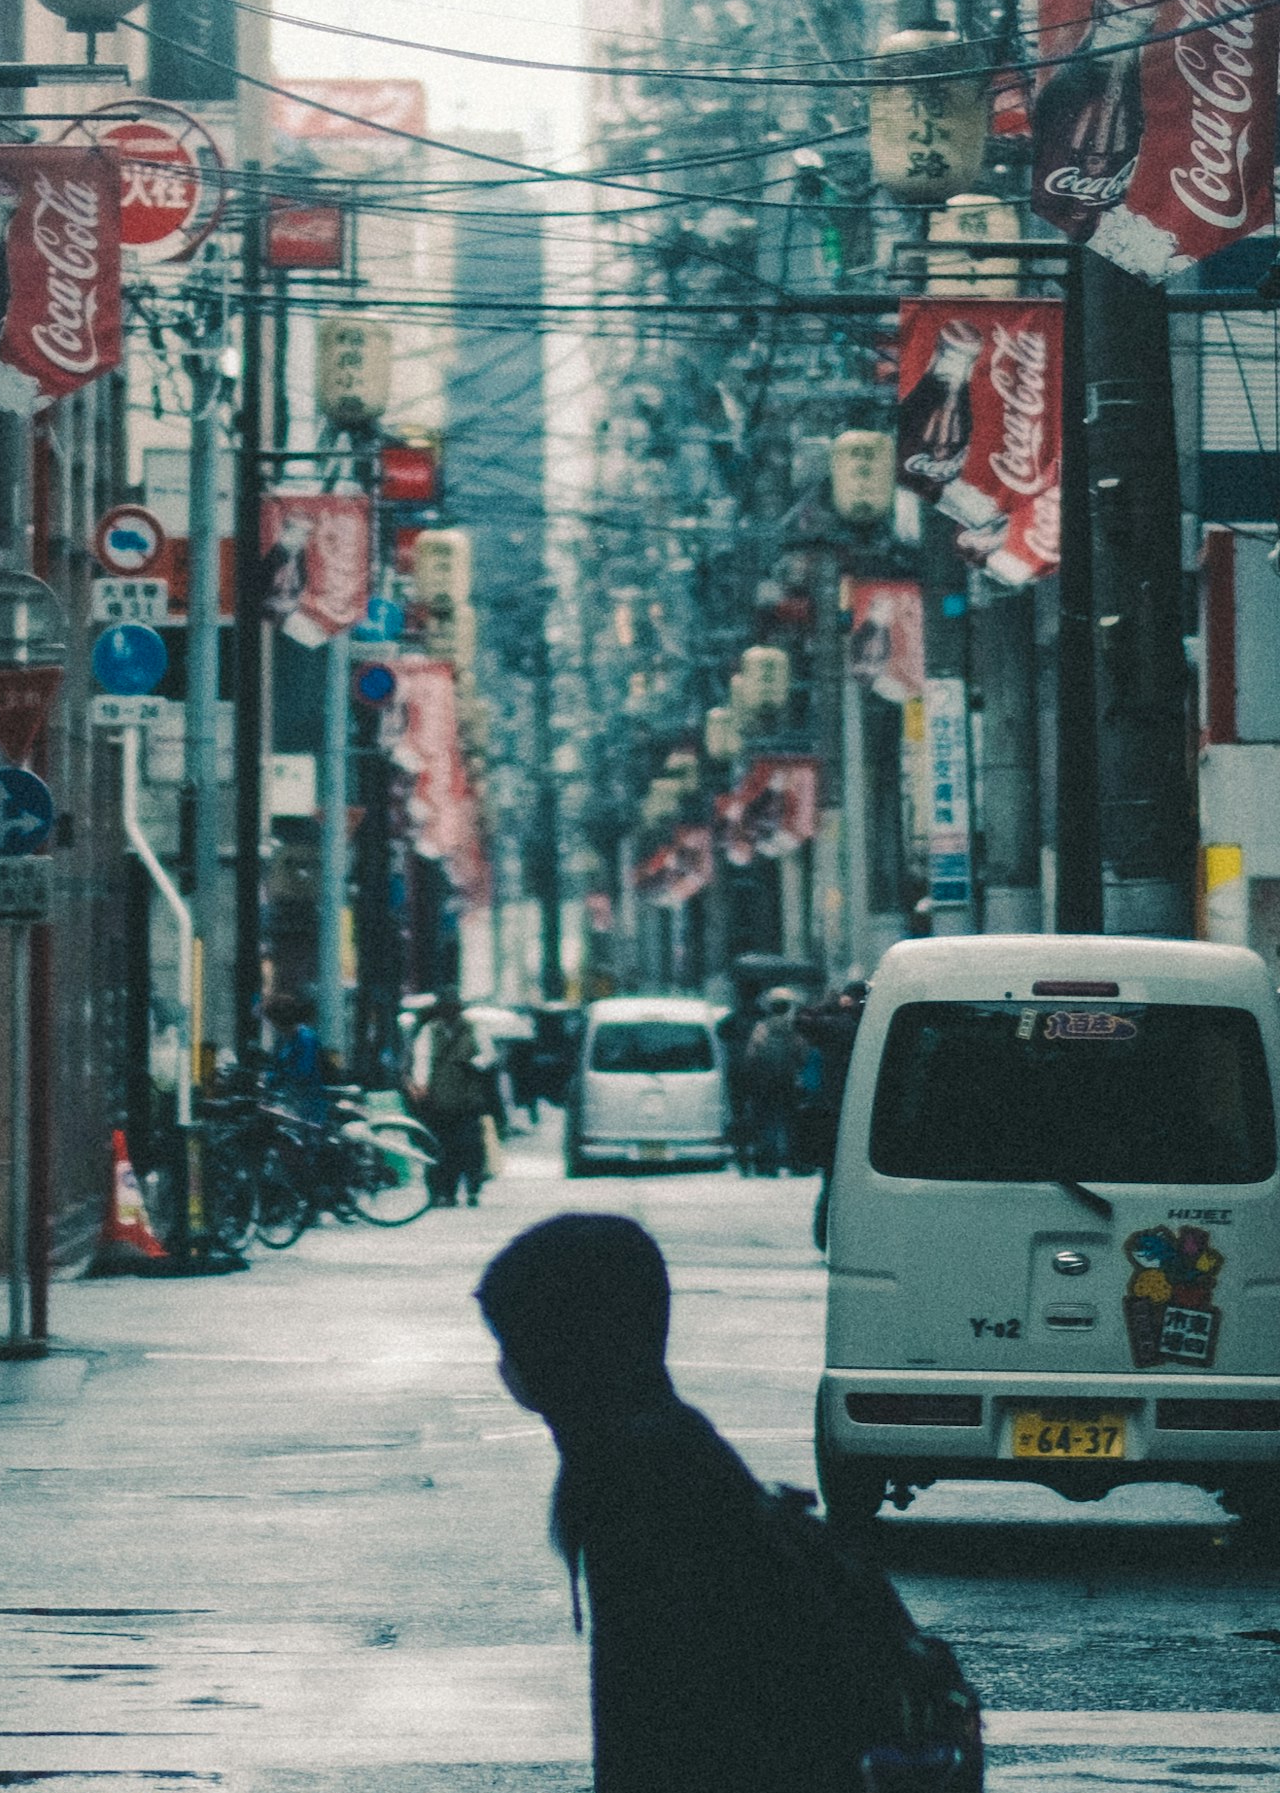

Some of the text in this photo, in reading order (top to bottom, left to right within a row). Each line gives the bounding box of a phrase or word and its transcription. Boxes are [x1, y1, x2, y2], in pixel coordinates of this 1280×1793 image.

[30, 170, 102, 375] Coca-Cola
[988, 321, 1050, 496] Coca-Cola
[1167, 1209, 1233, 1221] HIJET
[1037, 1426, 1119, 1454] 64-37
